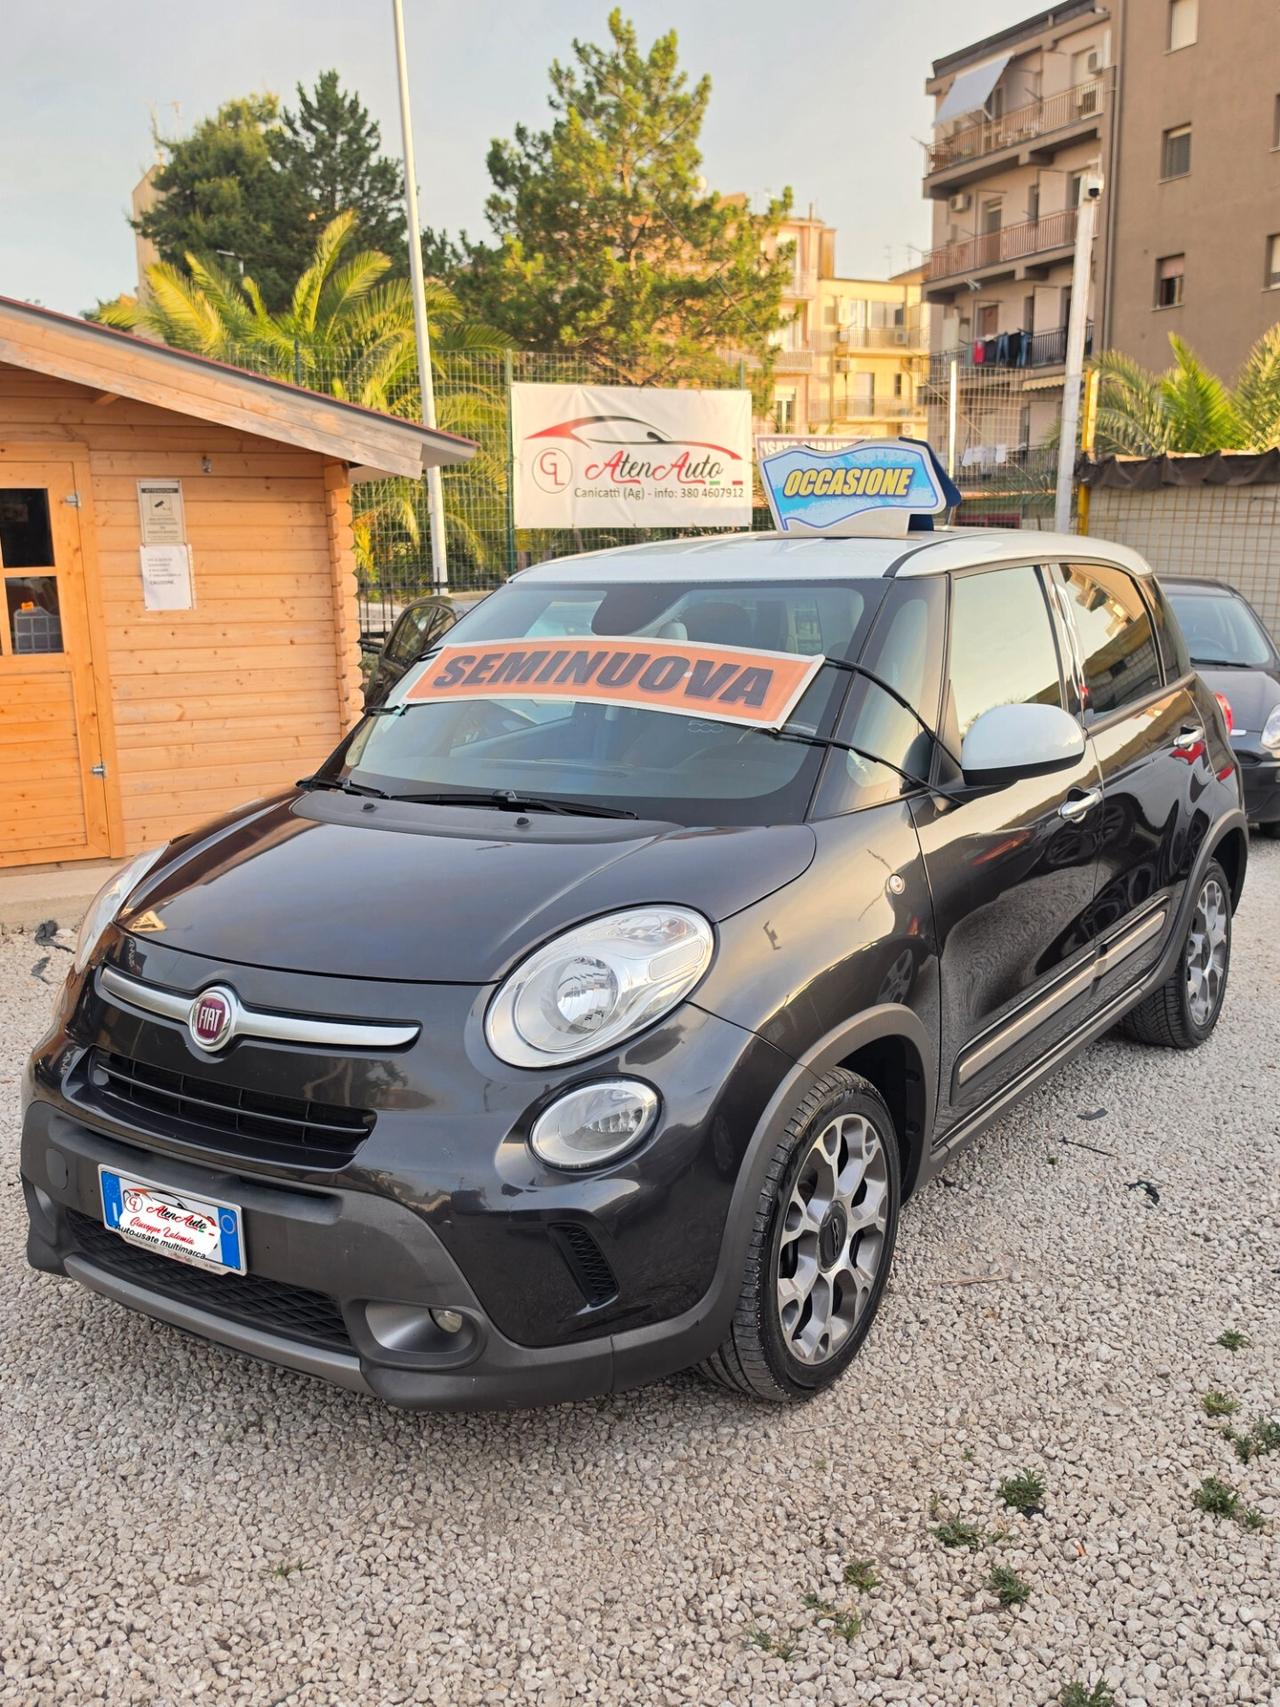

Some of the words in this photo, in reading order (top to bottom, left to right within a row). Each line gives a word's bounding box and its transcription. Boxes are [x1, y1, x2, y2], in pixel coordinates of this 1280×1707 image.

[585, 450, 723, 484] AtenAuto
[783, 467, 915, 497] OCCASIONE
[623, 487, 645, 500] (Ag)
[654, 487, 678, 498] info:
[681, 487, 699, 498] 380
[702, 487, 744, 498] 4607912
[432, 650, 774, 709] SEMINUOVA
[198, 1006, 222, 1032] FIAT
